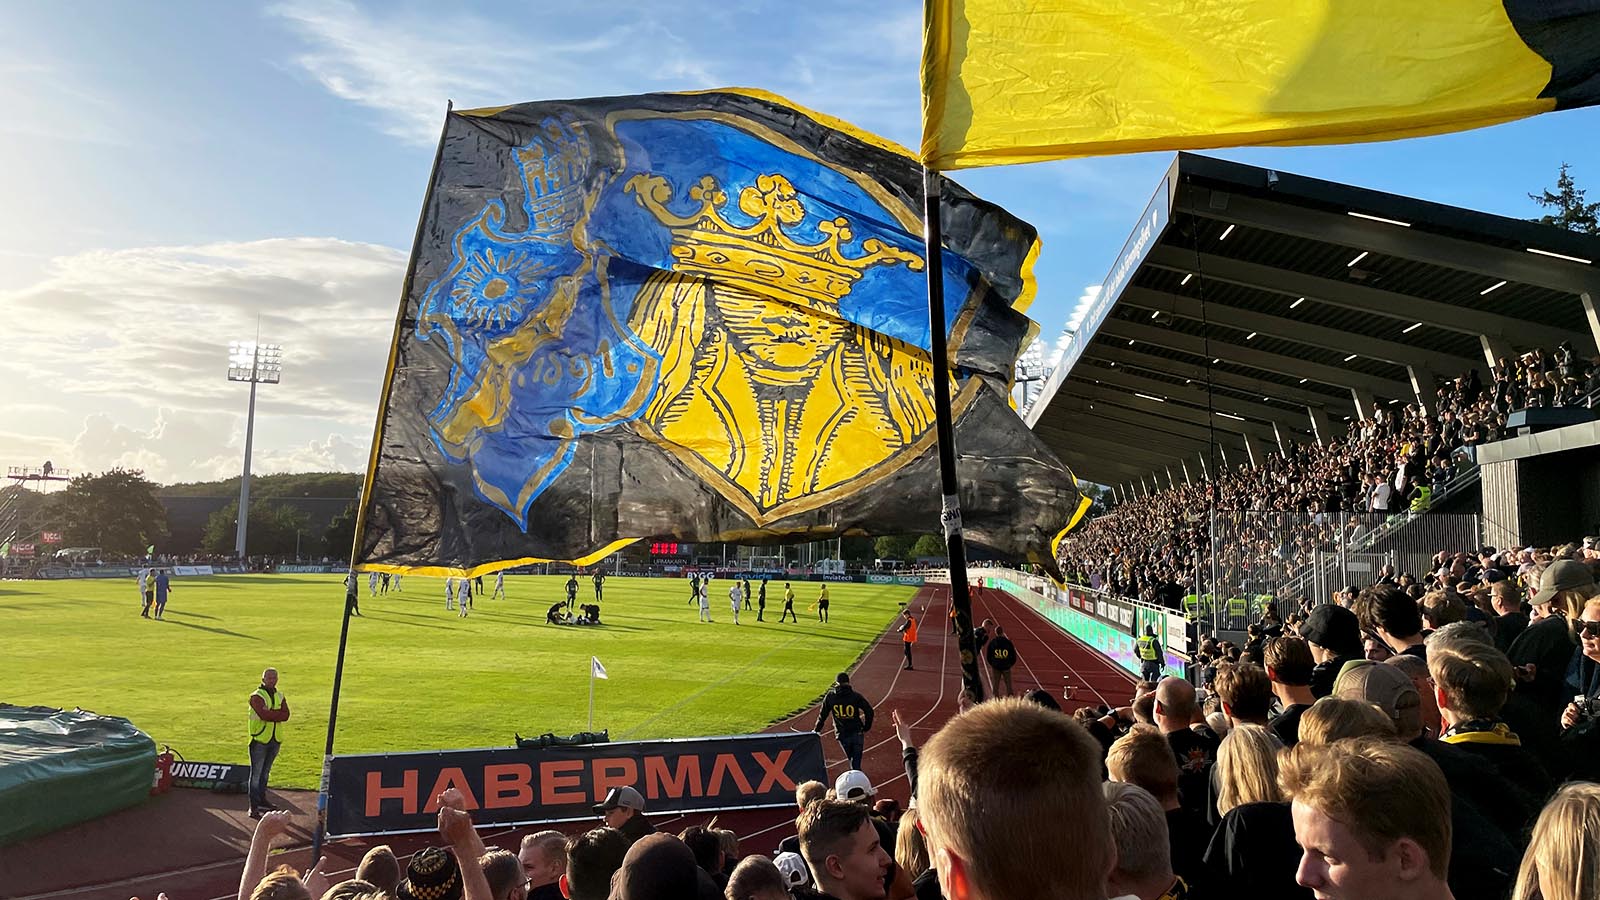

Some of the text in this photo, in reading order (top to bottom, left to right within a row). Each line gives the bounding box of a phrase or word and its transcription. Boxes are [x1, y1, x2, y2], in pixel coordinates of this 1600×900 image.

[687, 571, 715, 580] BYGG
[870, 575, 893, 583] coop
[898, 576, 921, 585] coop
[994, 648, 1009, 659] SLO
[833, 704, 855, 717] SLO
[169, 763, 232, 780] UNIBET
[365, 750, 796, 817] HABERMAX
